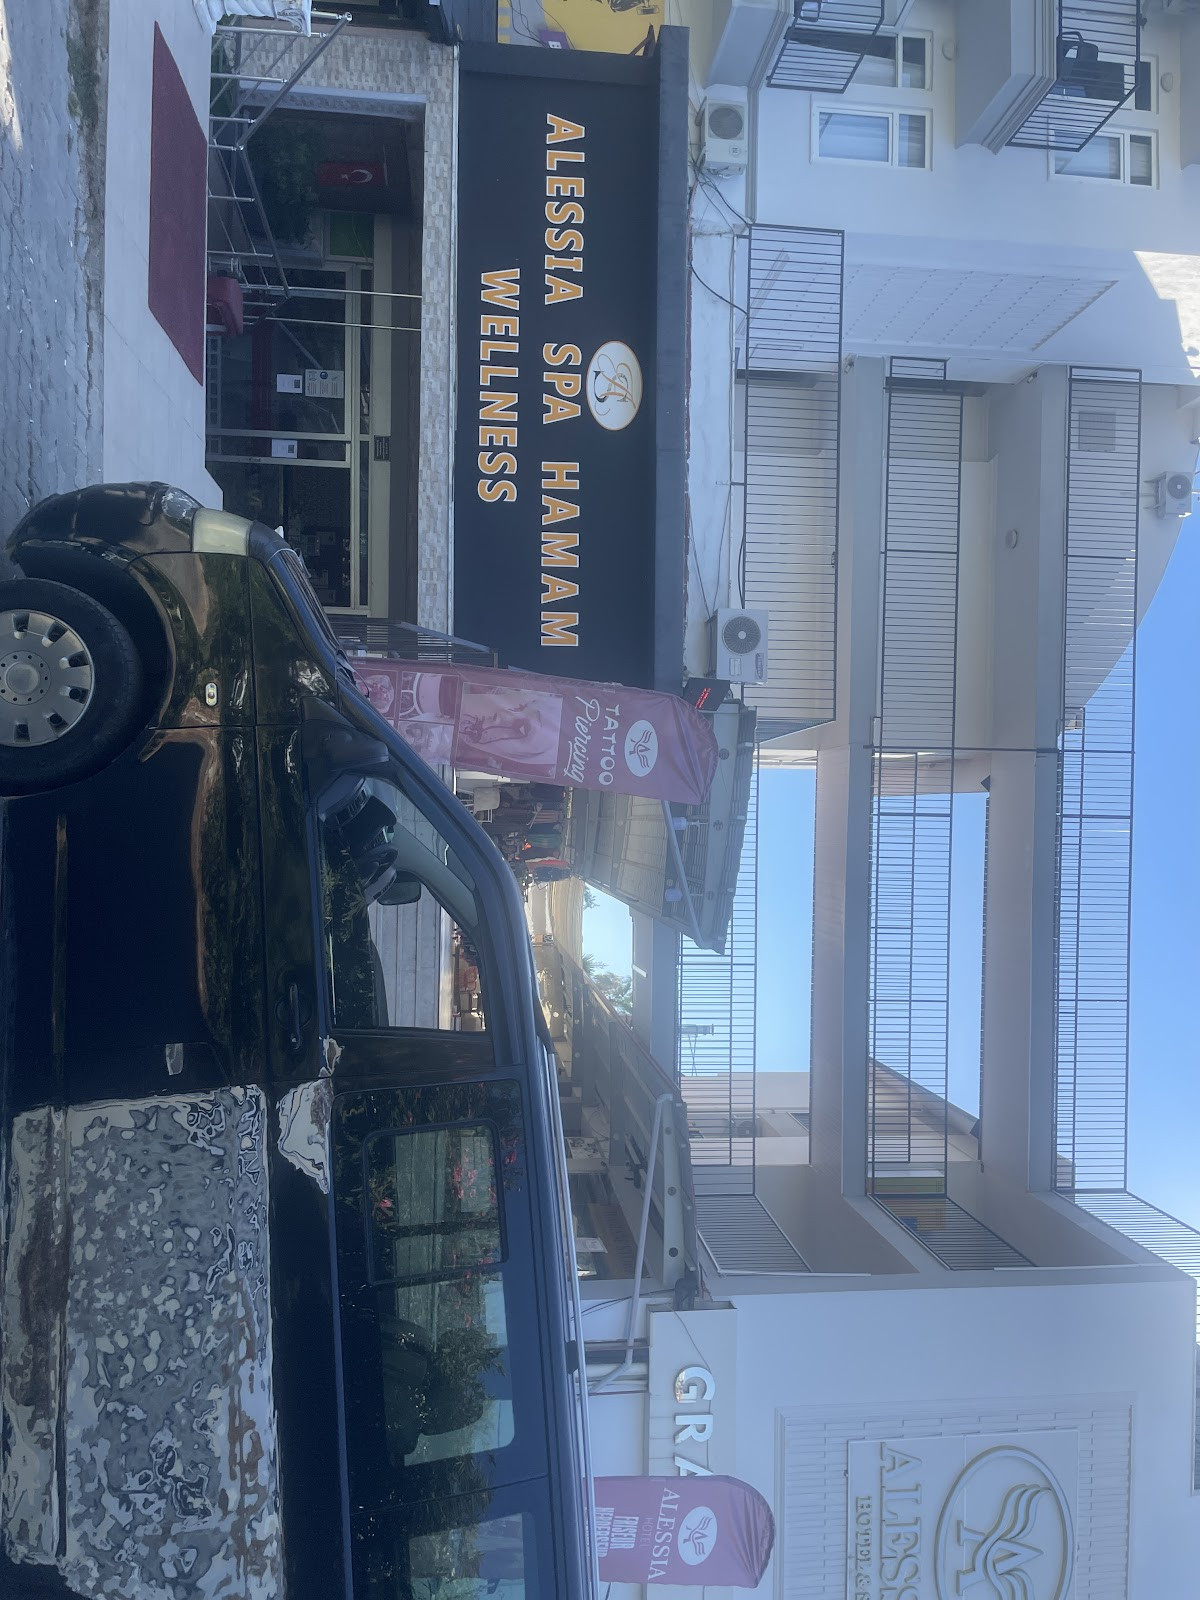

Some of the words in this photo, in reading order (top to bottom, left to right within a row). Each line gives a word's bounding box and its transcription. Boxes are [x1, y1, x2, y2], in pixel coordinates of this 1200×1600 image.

[544, 113, 586, 306] ALESSIA
[477, 267, 521, 504] WELLNESS
[542, 342, 583, 425] SPA
[540, 460, 580, 648] HAMAM
[563, 696, 600, 783] Piercing
[598, 704, 620, 786] TATTOO
[609, 1516, 640, 1550] FRISEUR
[639, 1517, 654, 1549] HOTEL
[647, 1487, 681, 1581] ALESSIA
[855, 1496, 872, 1571] HOTEL
